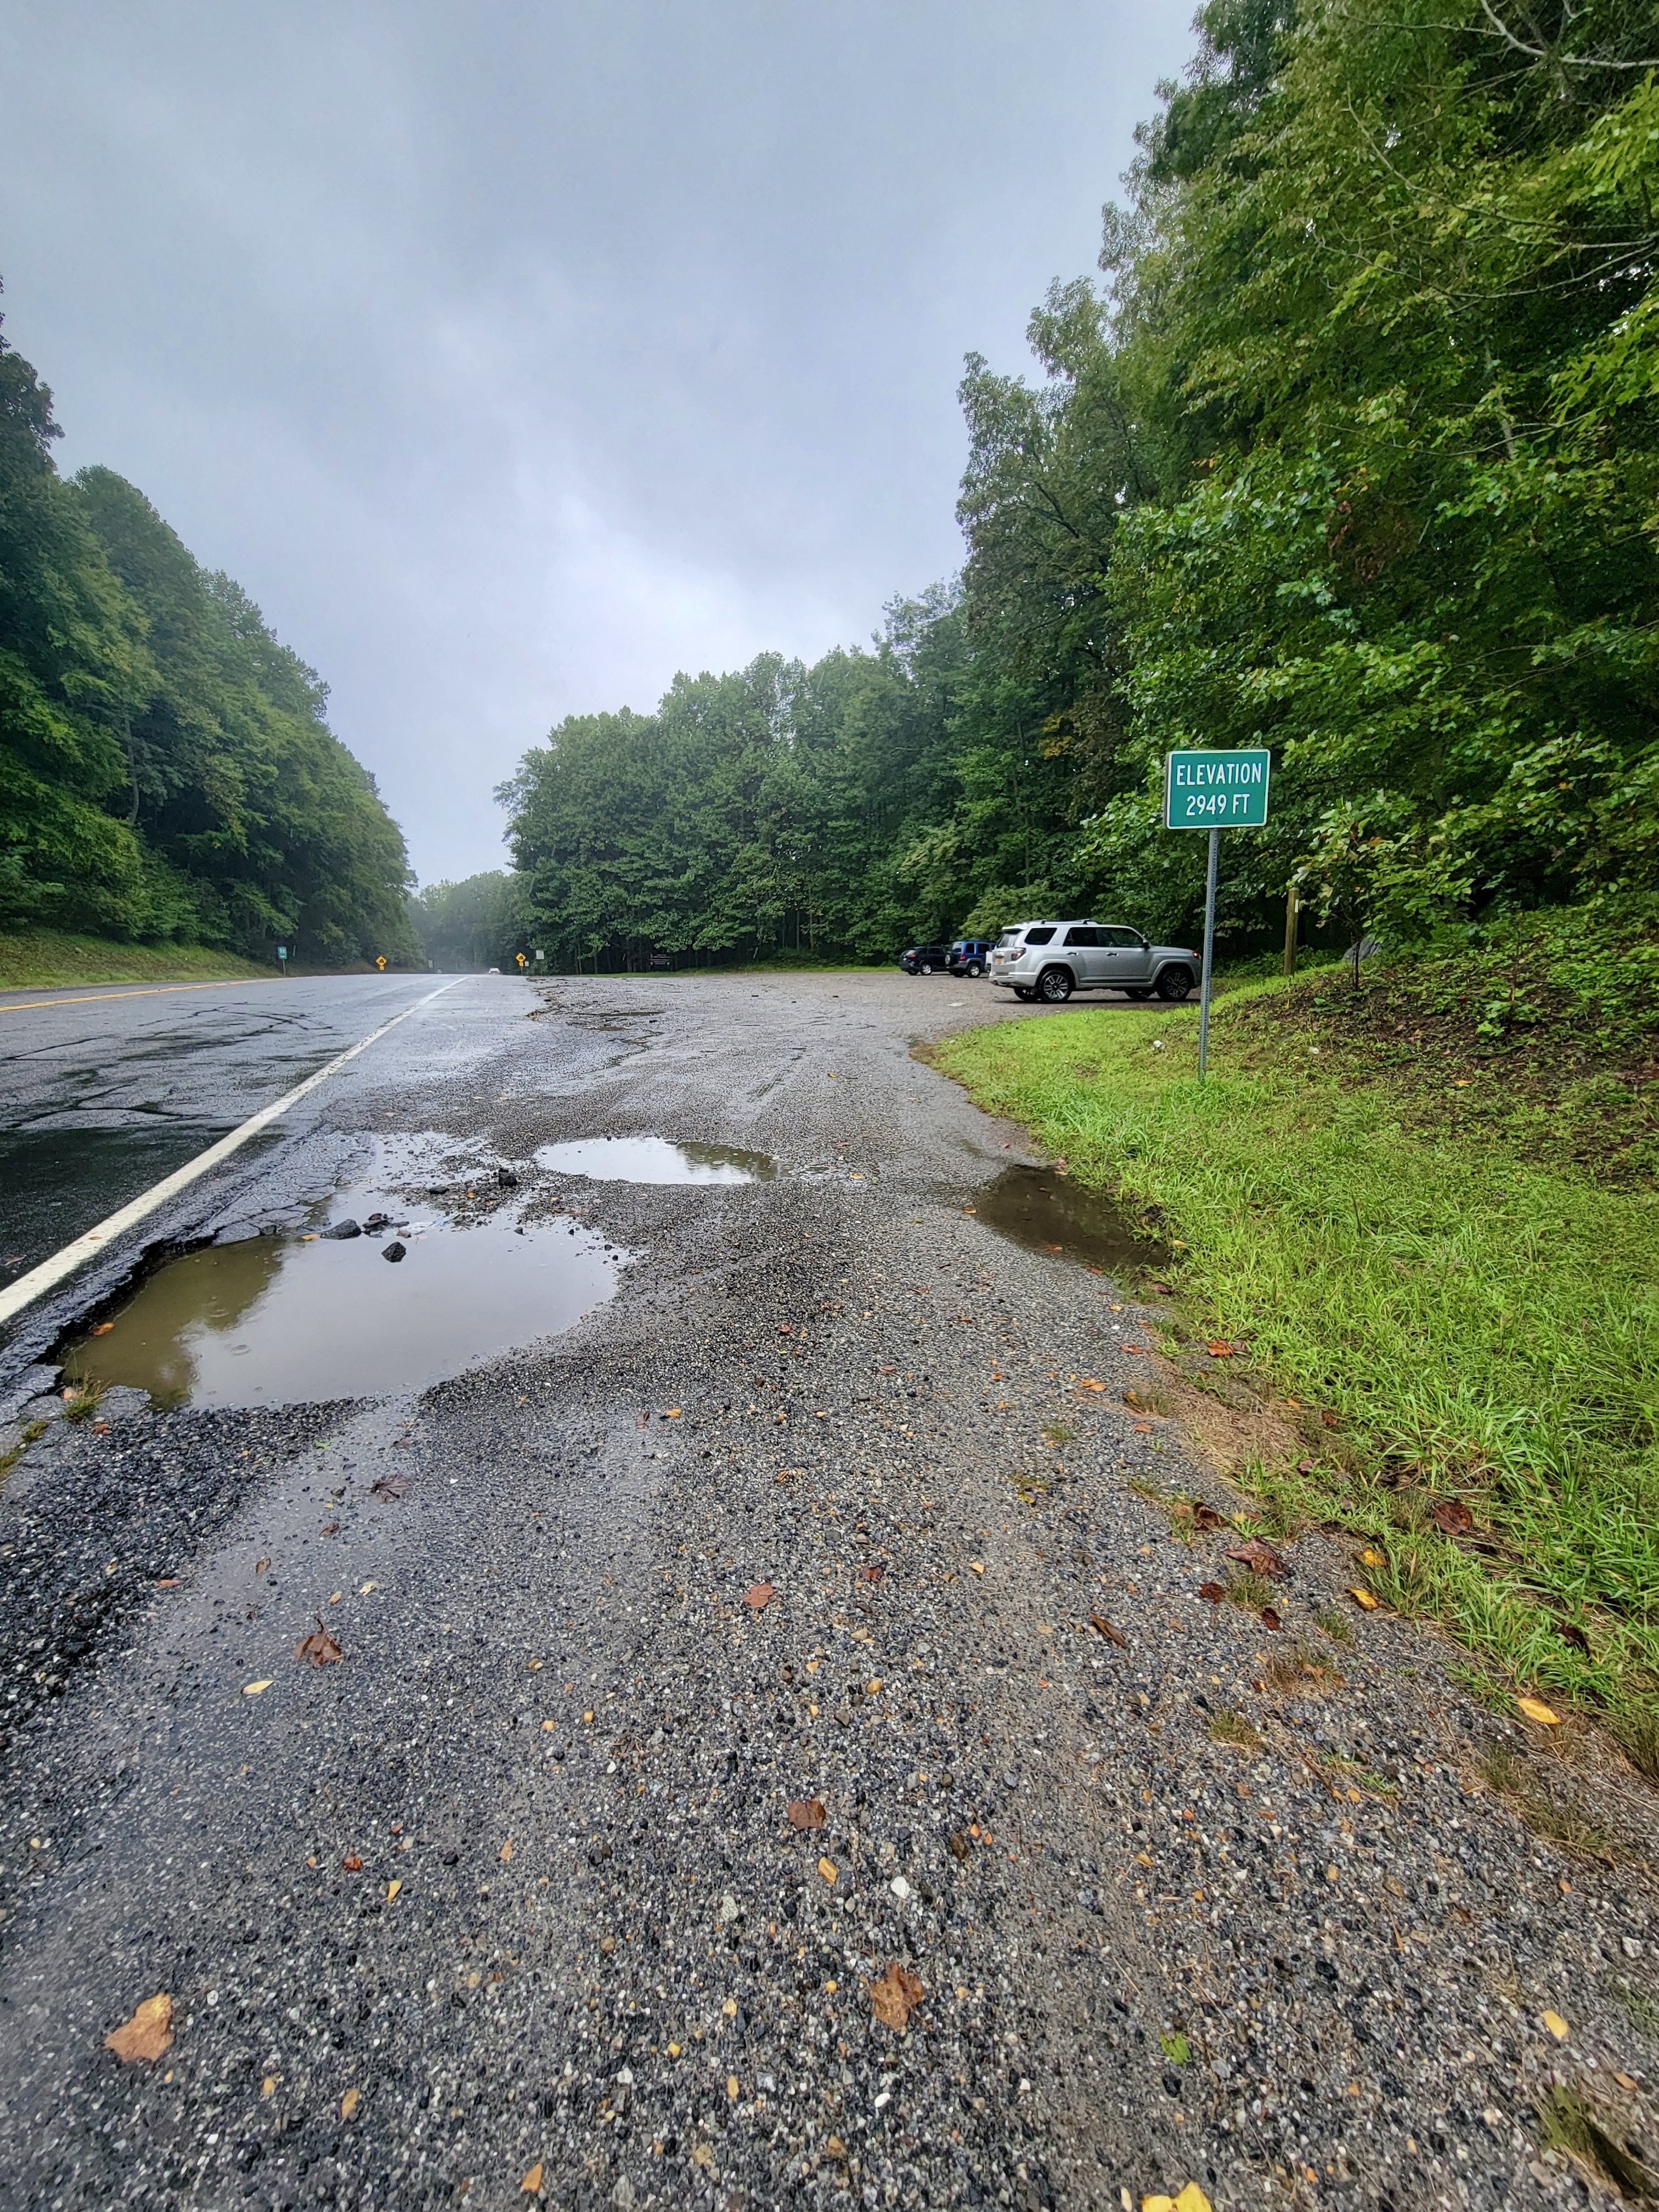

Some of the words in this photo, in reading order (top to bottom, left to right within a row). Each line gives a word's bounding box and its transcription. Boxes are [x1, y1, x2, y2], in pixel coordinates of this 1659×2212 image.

[1177, 763, 1261, 785] ELEVATION
[1186, 794, 1227, 816] 2949
[1233, 794, 1250, 814] FT
